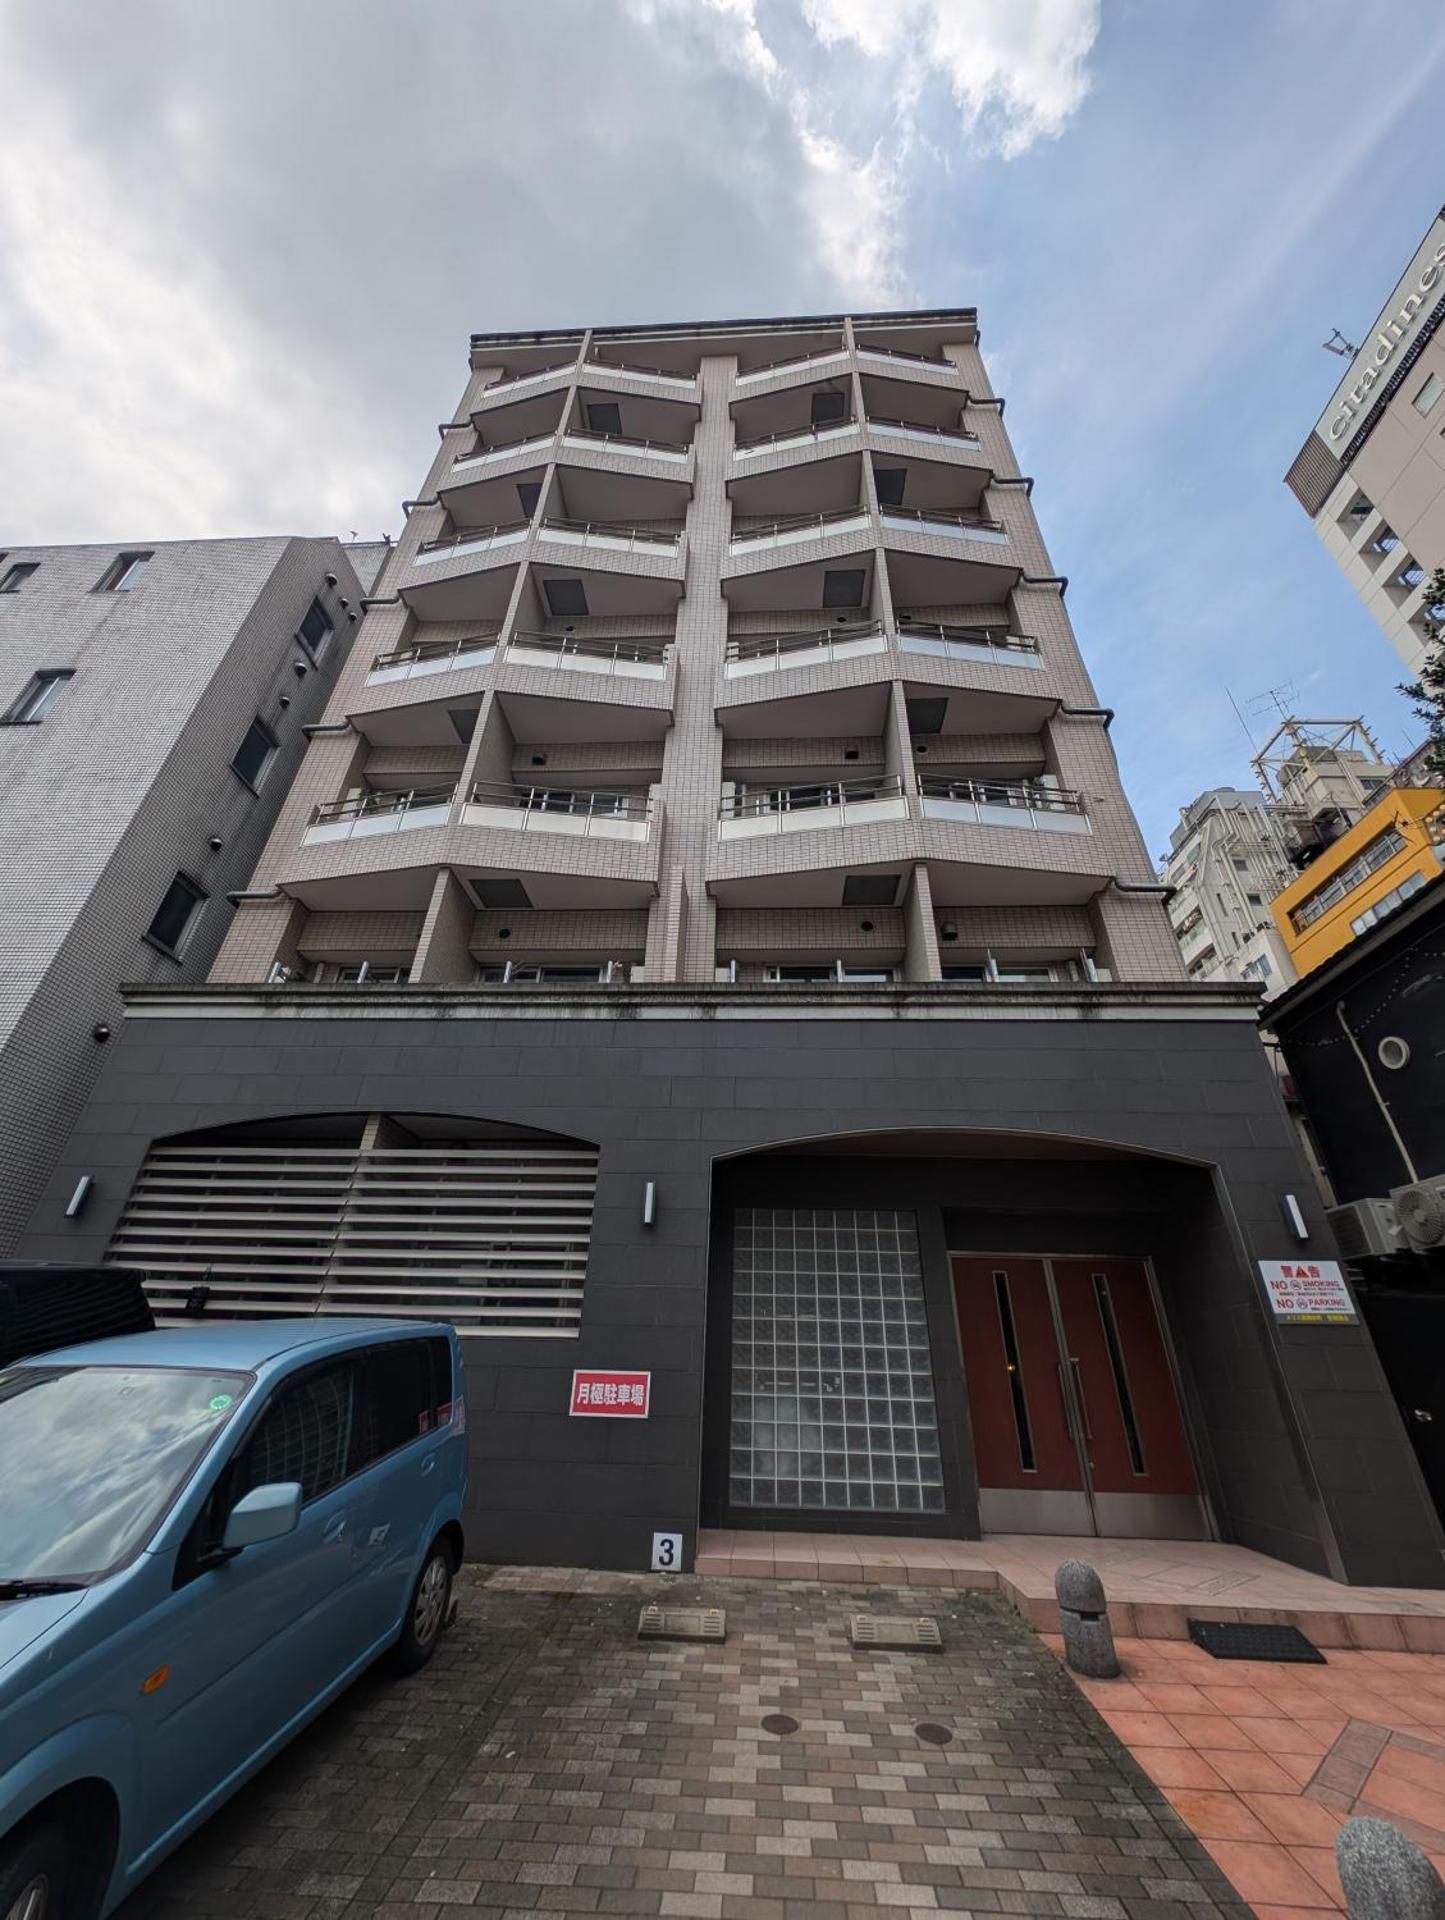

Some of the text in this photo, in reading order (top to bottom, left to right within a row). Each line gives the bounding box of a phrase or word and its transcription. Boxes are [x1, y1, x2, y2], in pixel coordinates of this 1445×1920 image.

[1270, 1281, 1288, 1290] NO
[1276, 1299, 1346, 1309] NO PARKING
[577, 1383, 644, 1406] 月極駐車場
[659, 1538, 674, 1566] 3
